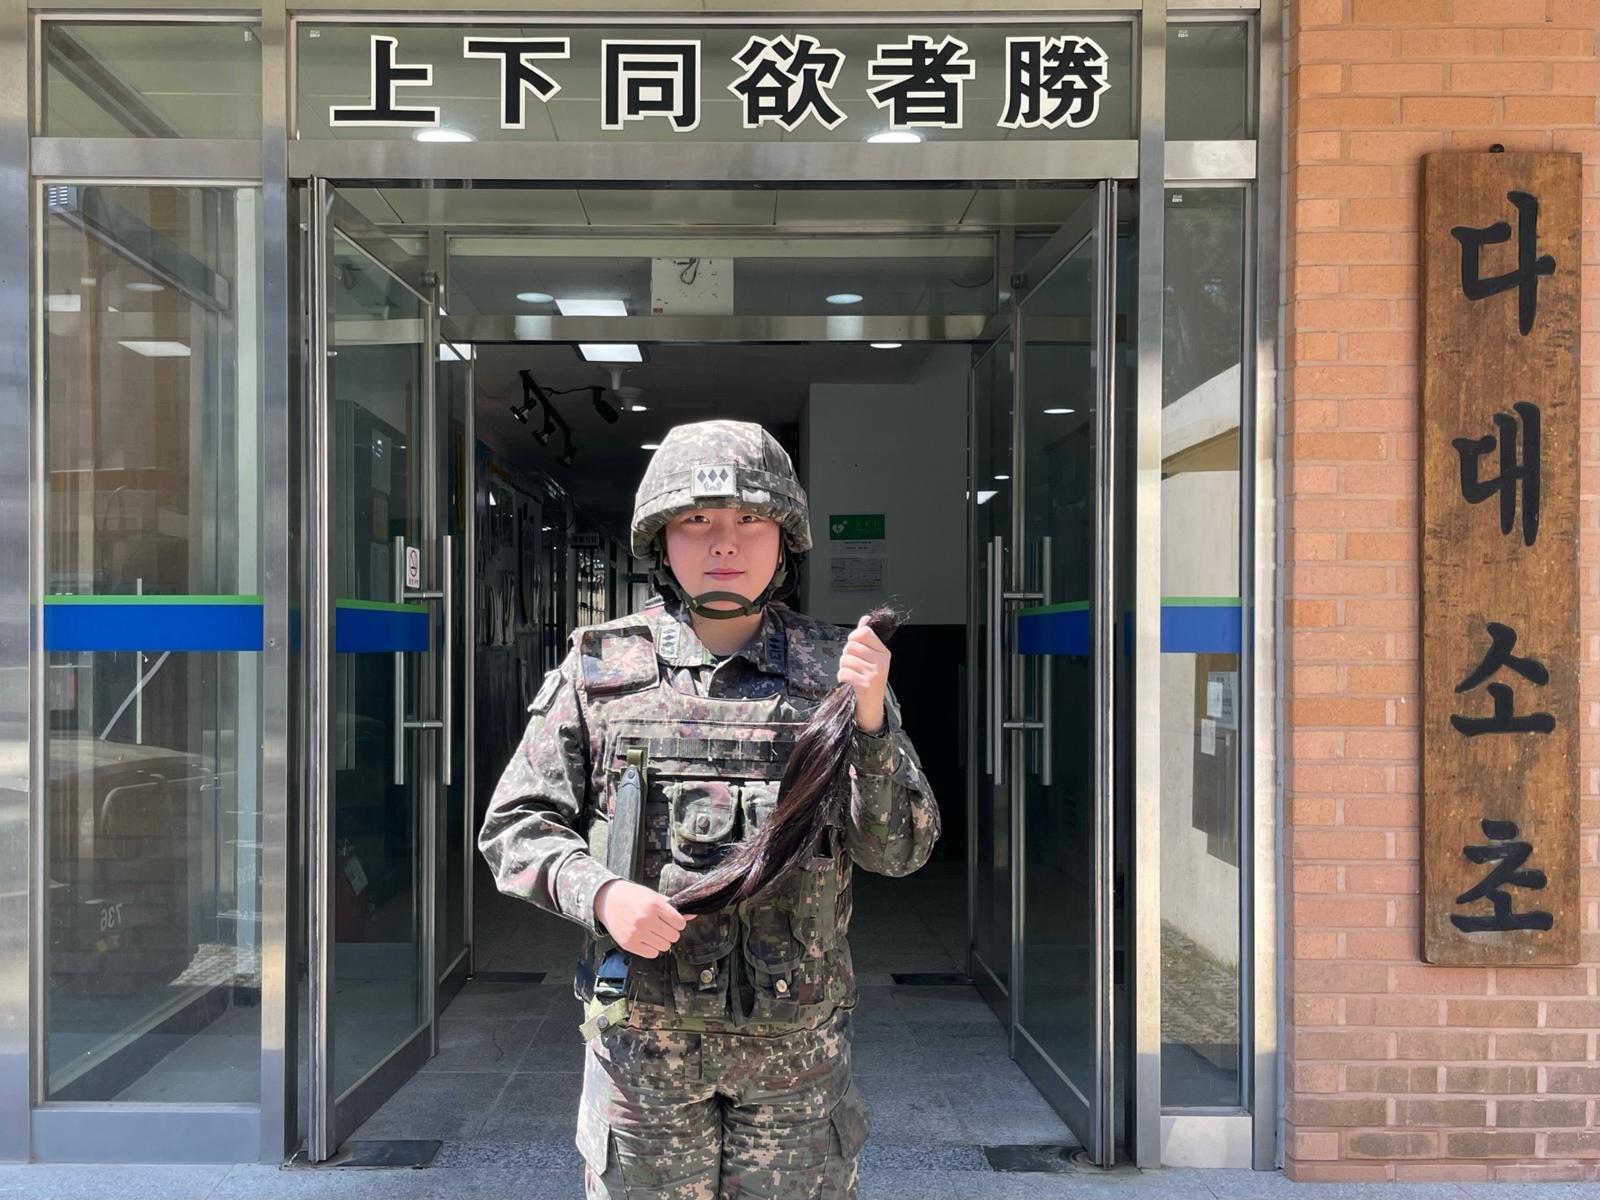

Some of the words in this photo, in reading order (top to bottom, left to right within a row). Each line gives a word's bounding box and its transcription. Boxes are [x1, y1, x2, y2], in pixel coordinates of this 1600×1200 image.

[330, 34, 1112, 132] 上下同欲者勝
[1451, 190, 1556, 933] 다대소초
